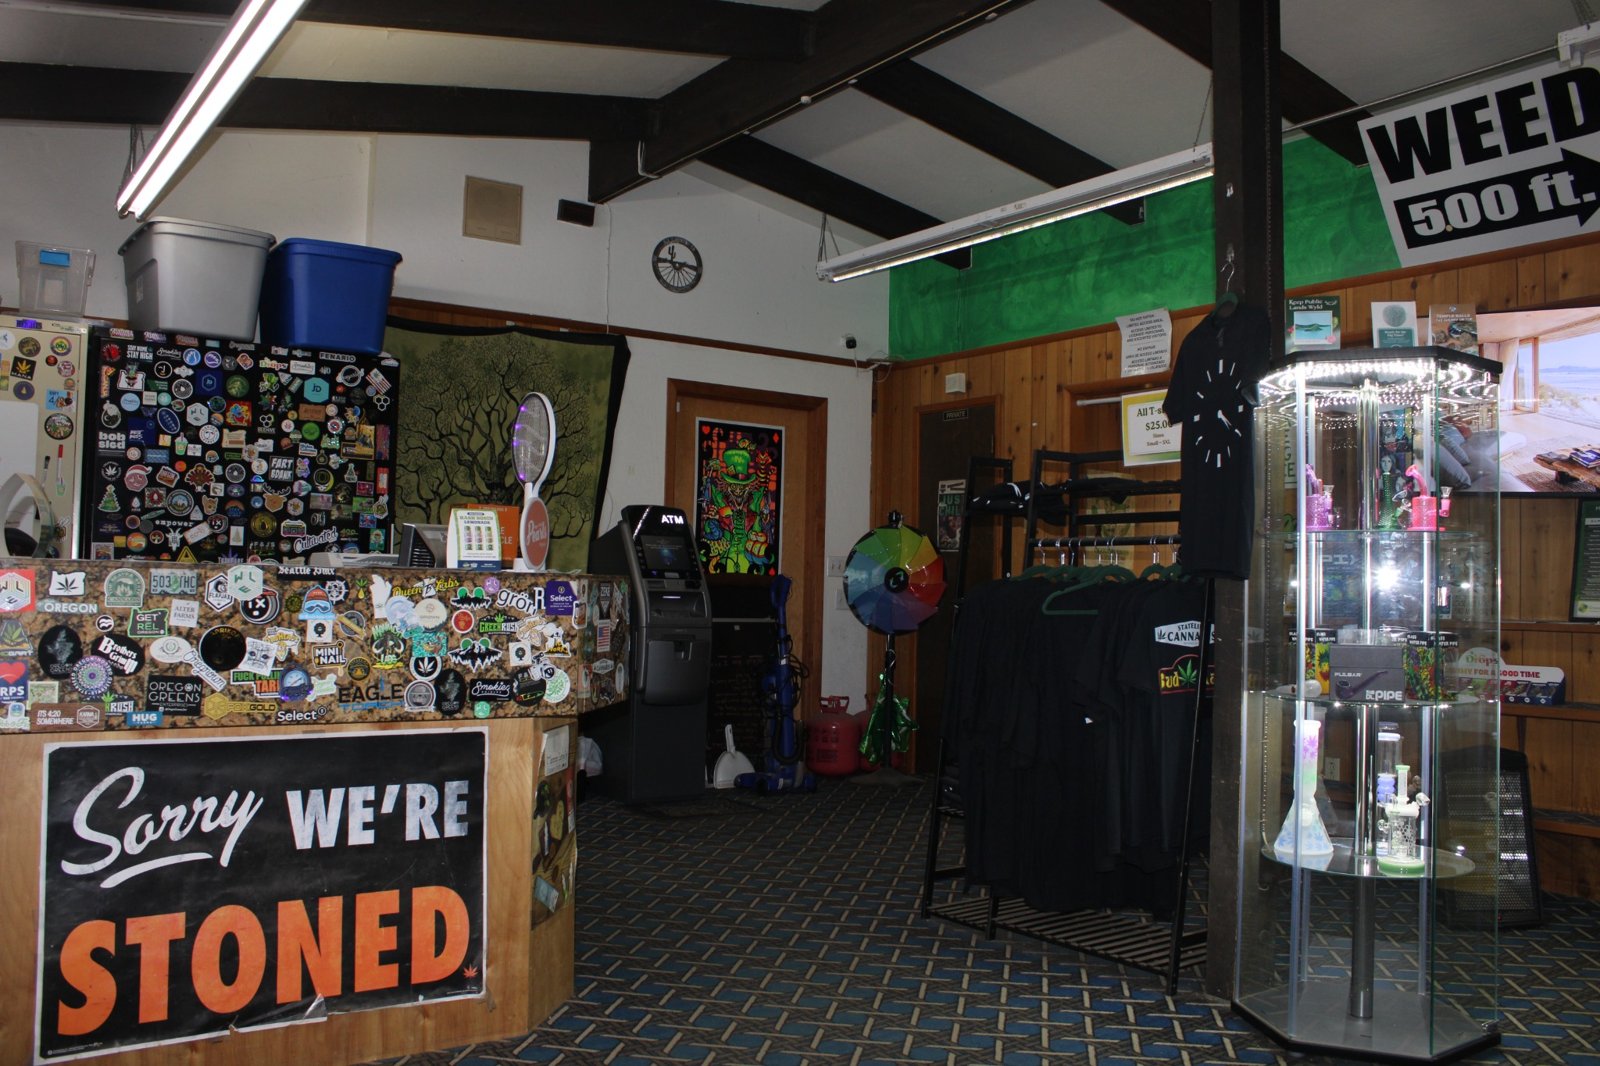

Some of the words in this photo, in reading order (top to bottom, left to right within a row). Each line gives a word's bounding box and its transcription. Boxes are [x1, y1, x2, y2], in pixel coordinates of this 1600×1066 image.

[1366, 67, 1600, 184] WEED
[1528, 171, 1597, 212] ft.
[320, 352, 355, 362] FENARIO
[1137, 407, 1148, 417] All
[98, 431, 126, 441] bob
[271, 457, 293, 469] FART
[154, 519, 195, 528] empower
[661, 514, 685, 525] ATM
[293, 526, 338, 553] Cultivated
[152, 576, 171, 589] 503
[392, 585, 423, 598] Queen
[435, 577, 461, 592] Labs
[550, 594, 573, 602] Select
[44, 603, 97, 613] OREGON
[136, 613, 159, 622] GET
[137, 622, 159, 630] REL
[479, 622, 502, 633] GREEN
[98, 635, 138, 659] Brothers
[315, 646, 339, 656] MINI
[320, 655, 346, 665] NAIL
[233, 671, 255, 682] FUCK
[1520, 670, 1541, 679] TIME
[149, 682, 202, 692] OREGON
[148, 691, 201, 703] GREENS
[338, 683, 405, 704] EAGLE
[1374, 690, 1403, 701] PIPE
[110, 700, 134, 712] RUSH
[132, 713, 158, 722] HUG
[277, 709, 318, 722] Select
[36, 717, 75, 726] SOMEWHERE
[61, 766, 264, 876] Sorry
[286, 780, 470, 850] WE'RE
[57, 885, 471, 1036] STONED
